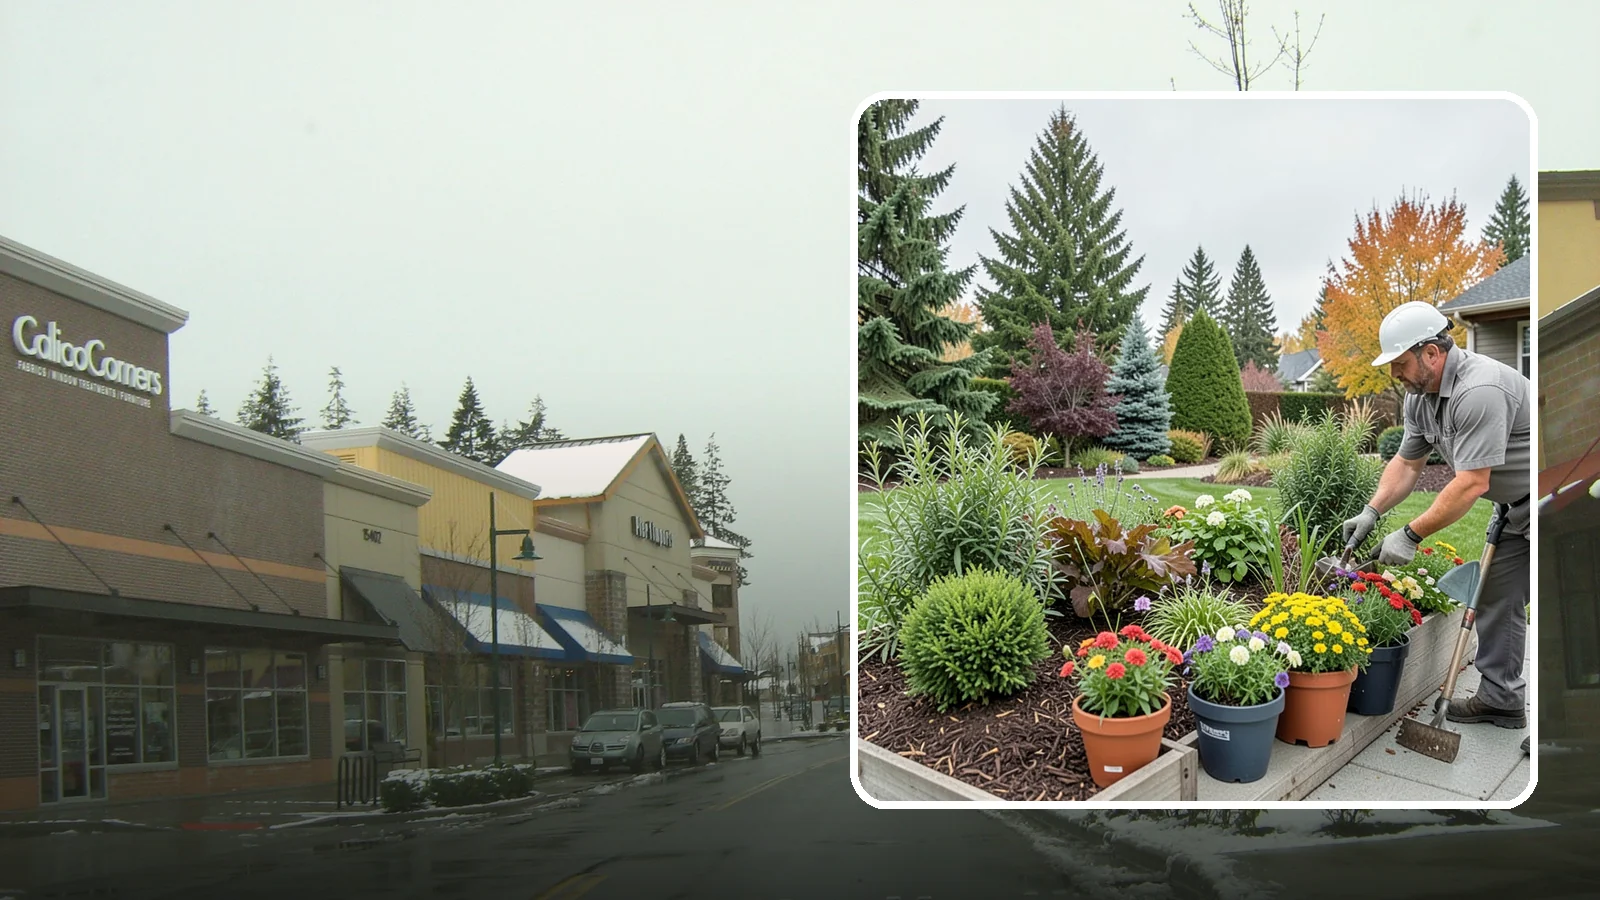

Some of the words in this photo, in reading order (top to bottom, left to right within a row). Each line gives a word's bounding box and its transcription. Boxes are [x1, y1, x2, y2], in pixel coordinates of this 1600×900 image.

[16, 359, 47, 378] FABRICS
[51, 369, 78, 387] WINDOW
[78, 378, 117, 399] TREATMENTS
[119, 390, 151, 409] FURNITURE
